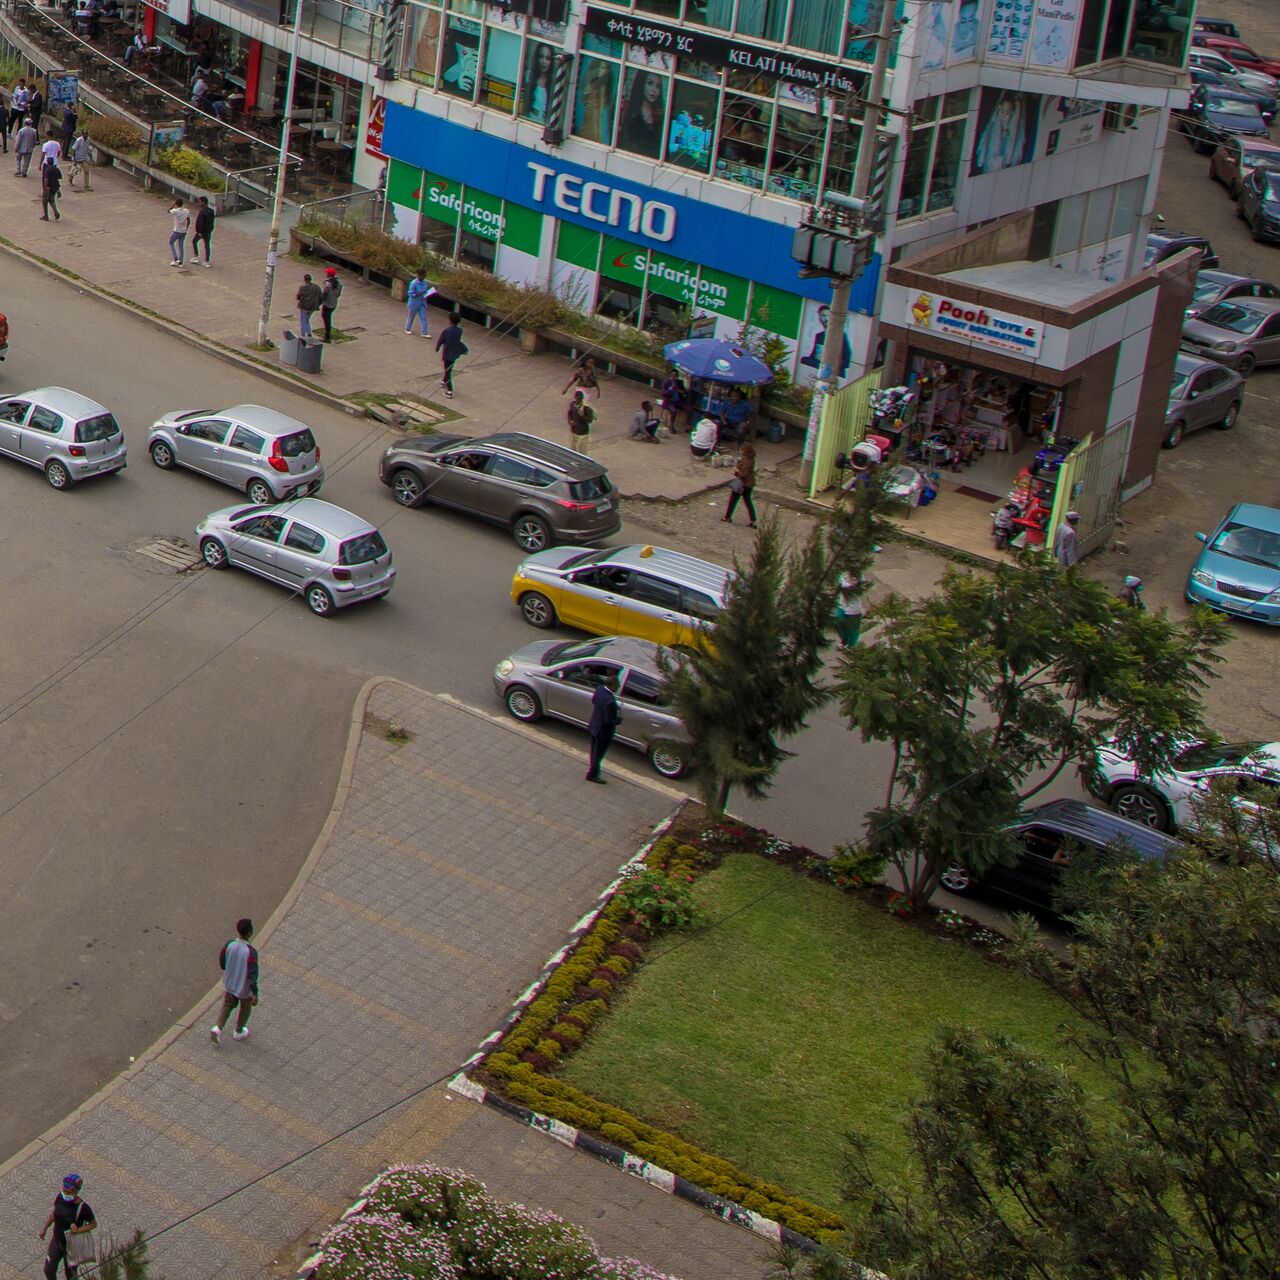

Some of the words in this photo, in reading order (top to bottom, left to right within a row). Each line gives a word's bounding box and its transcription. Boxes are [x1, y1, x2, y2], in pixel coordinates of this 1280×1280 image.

[729, 48, 778, 73] KELATI
[429, 186, 506, 229] Safaricom
[528, 161, 677, 243] TECNO
[633, 254, 728, 299] Safaricom
[938, 300, 990, 326] Pooh
